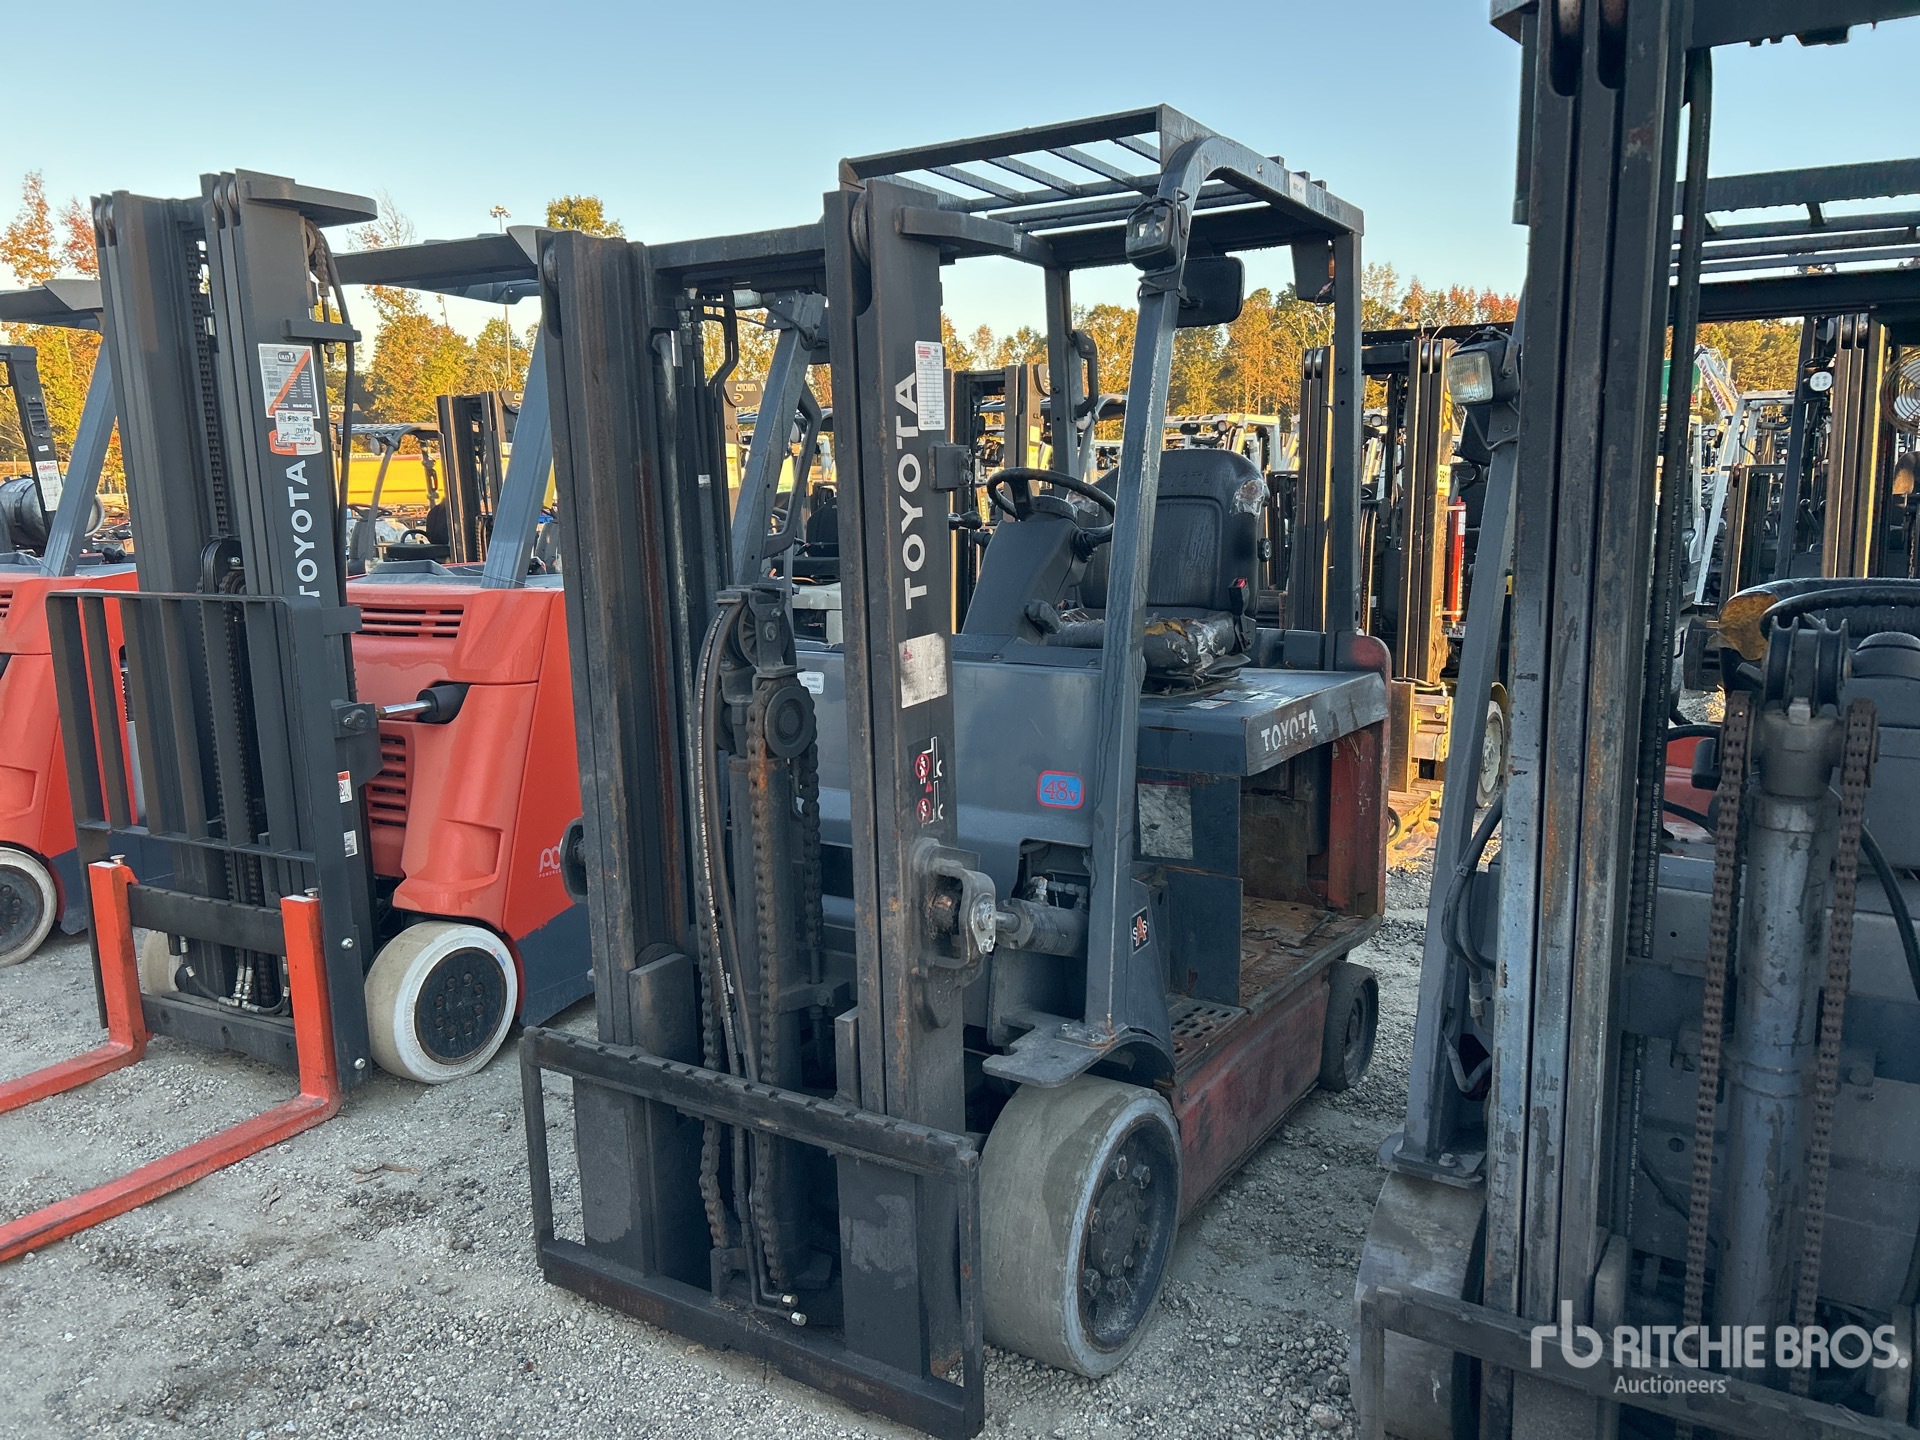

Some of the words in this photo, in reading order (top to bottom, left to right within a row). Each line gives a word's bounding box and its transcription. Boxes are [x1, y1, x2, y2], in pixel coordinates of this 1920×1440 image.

[1442, 379, 1453, 433] Yal
[1698, 359, 1726, 411] SUPERIOR
[895, 372, 928, 610] TOYOTA
[286, 459, 320, 598] TOYOTA
[1261, 708, 1318, 751] TOYOTA
